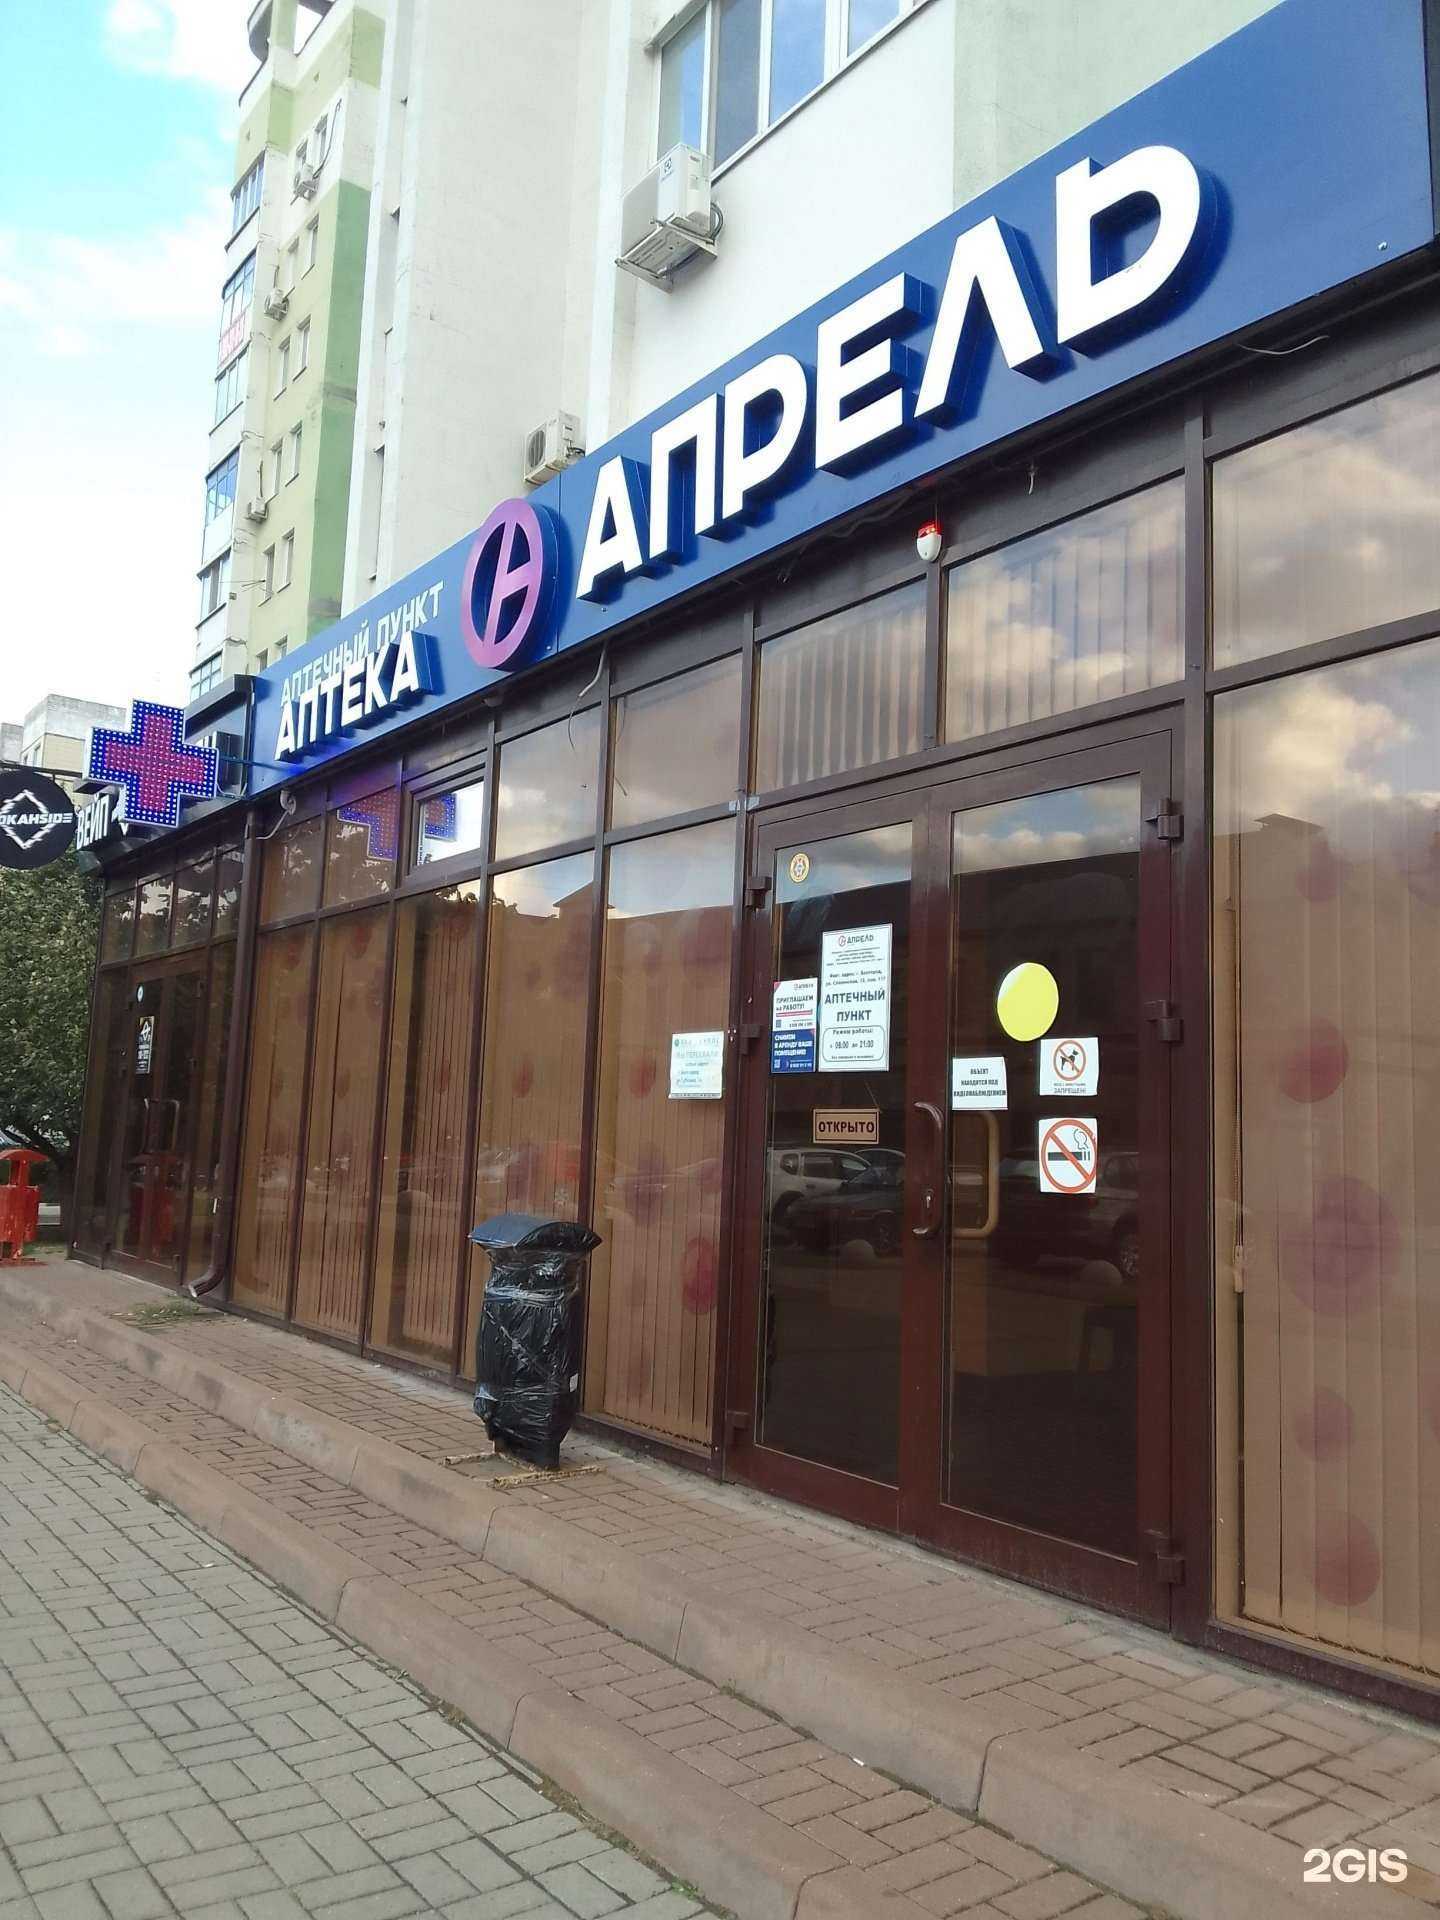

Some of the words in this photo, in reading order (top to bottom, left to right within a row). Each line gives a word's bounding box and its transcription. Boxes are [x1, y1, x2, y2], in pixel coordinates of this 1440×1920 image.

[576, 145, 1201, 600] АПРЕЛЬ
[280, 619, 370, 708] АПТЕЧНЫЙ
[376, 580, 444, 652] ПУНКТ
[275, 630, 420, 761] АПТЕКА
[76, 792, 110, 850] ВЕЙП
[825, 987, 886, 1005] АПТЕЧНЫЙ
[836, 1010, 872, 1022] ПУНКТ
[818, 1121, 875, 1133] ОТКРЫТО
